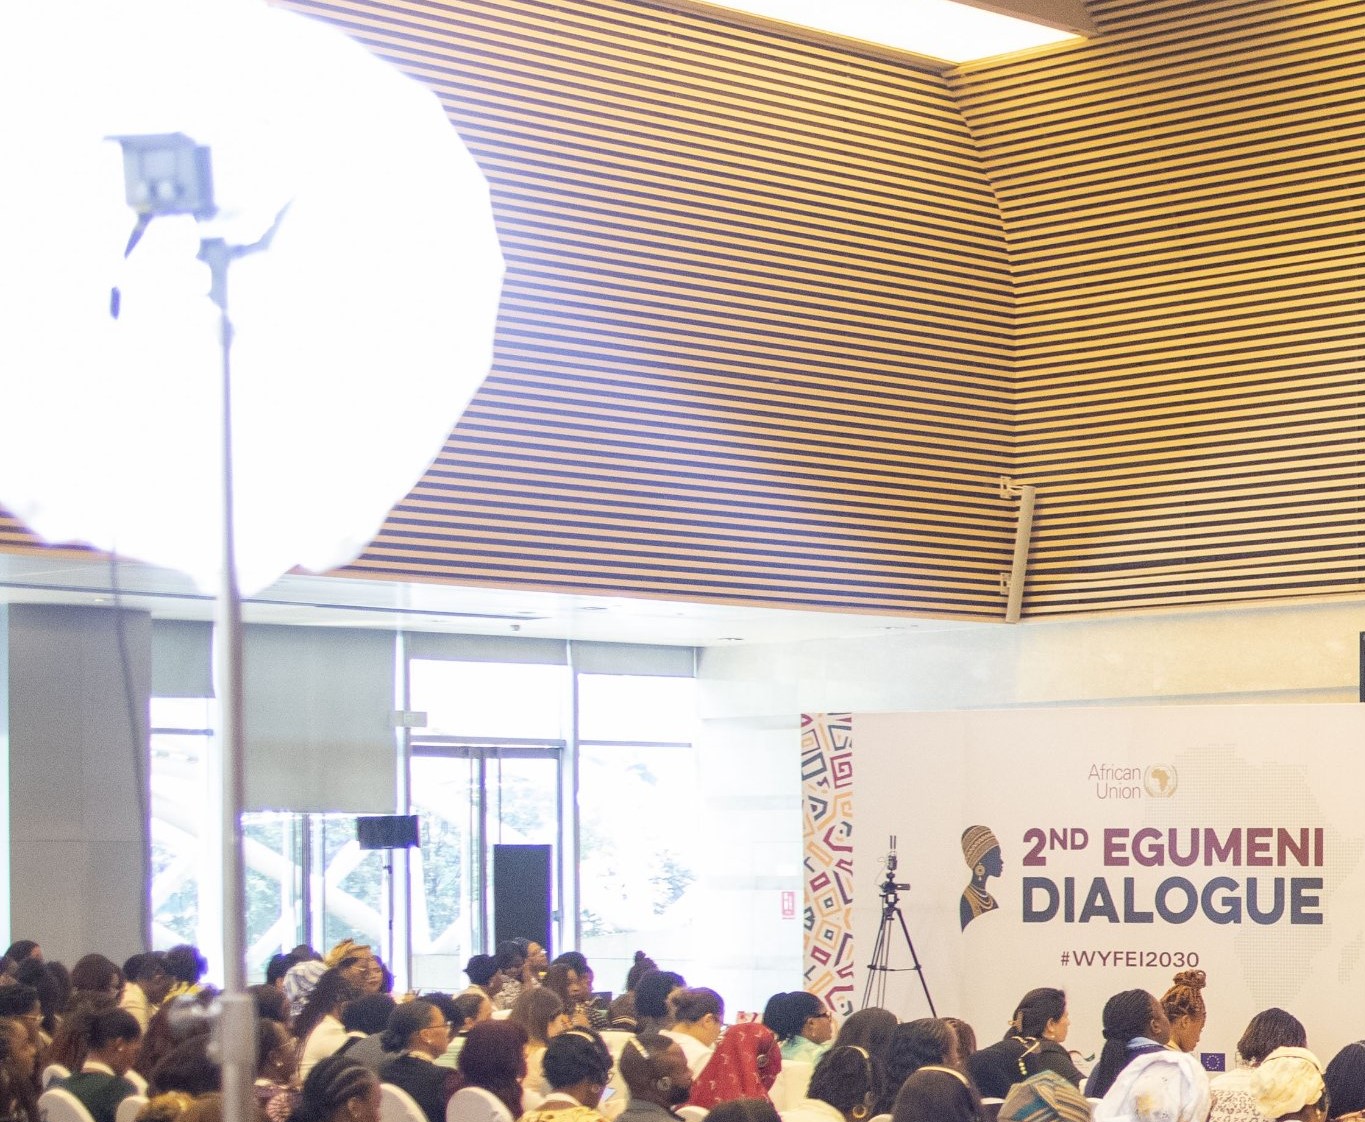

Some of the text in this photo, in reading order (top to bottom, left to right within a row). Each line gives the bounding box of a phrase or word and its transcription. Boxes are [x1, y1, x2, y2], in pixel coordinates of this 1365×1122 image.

[1088, 763, 1141, 781] African
[1096, 782, 1141, 799] Union
[1022, 827, 1324, 867] 2ND EGUMENI
[1022, 876, 1324, 925] DIALOGUE
[1061, 951, 1200, 968] #WYFEI2030
